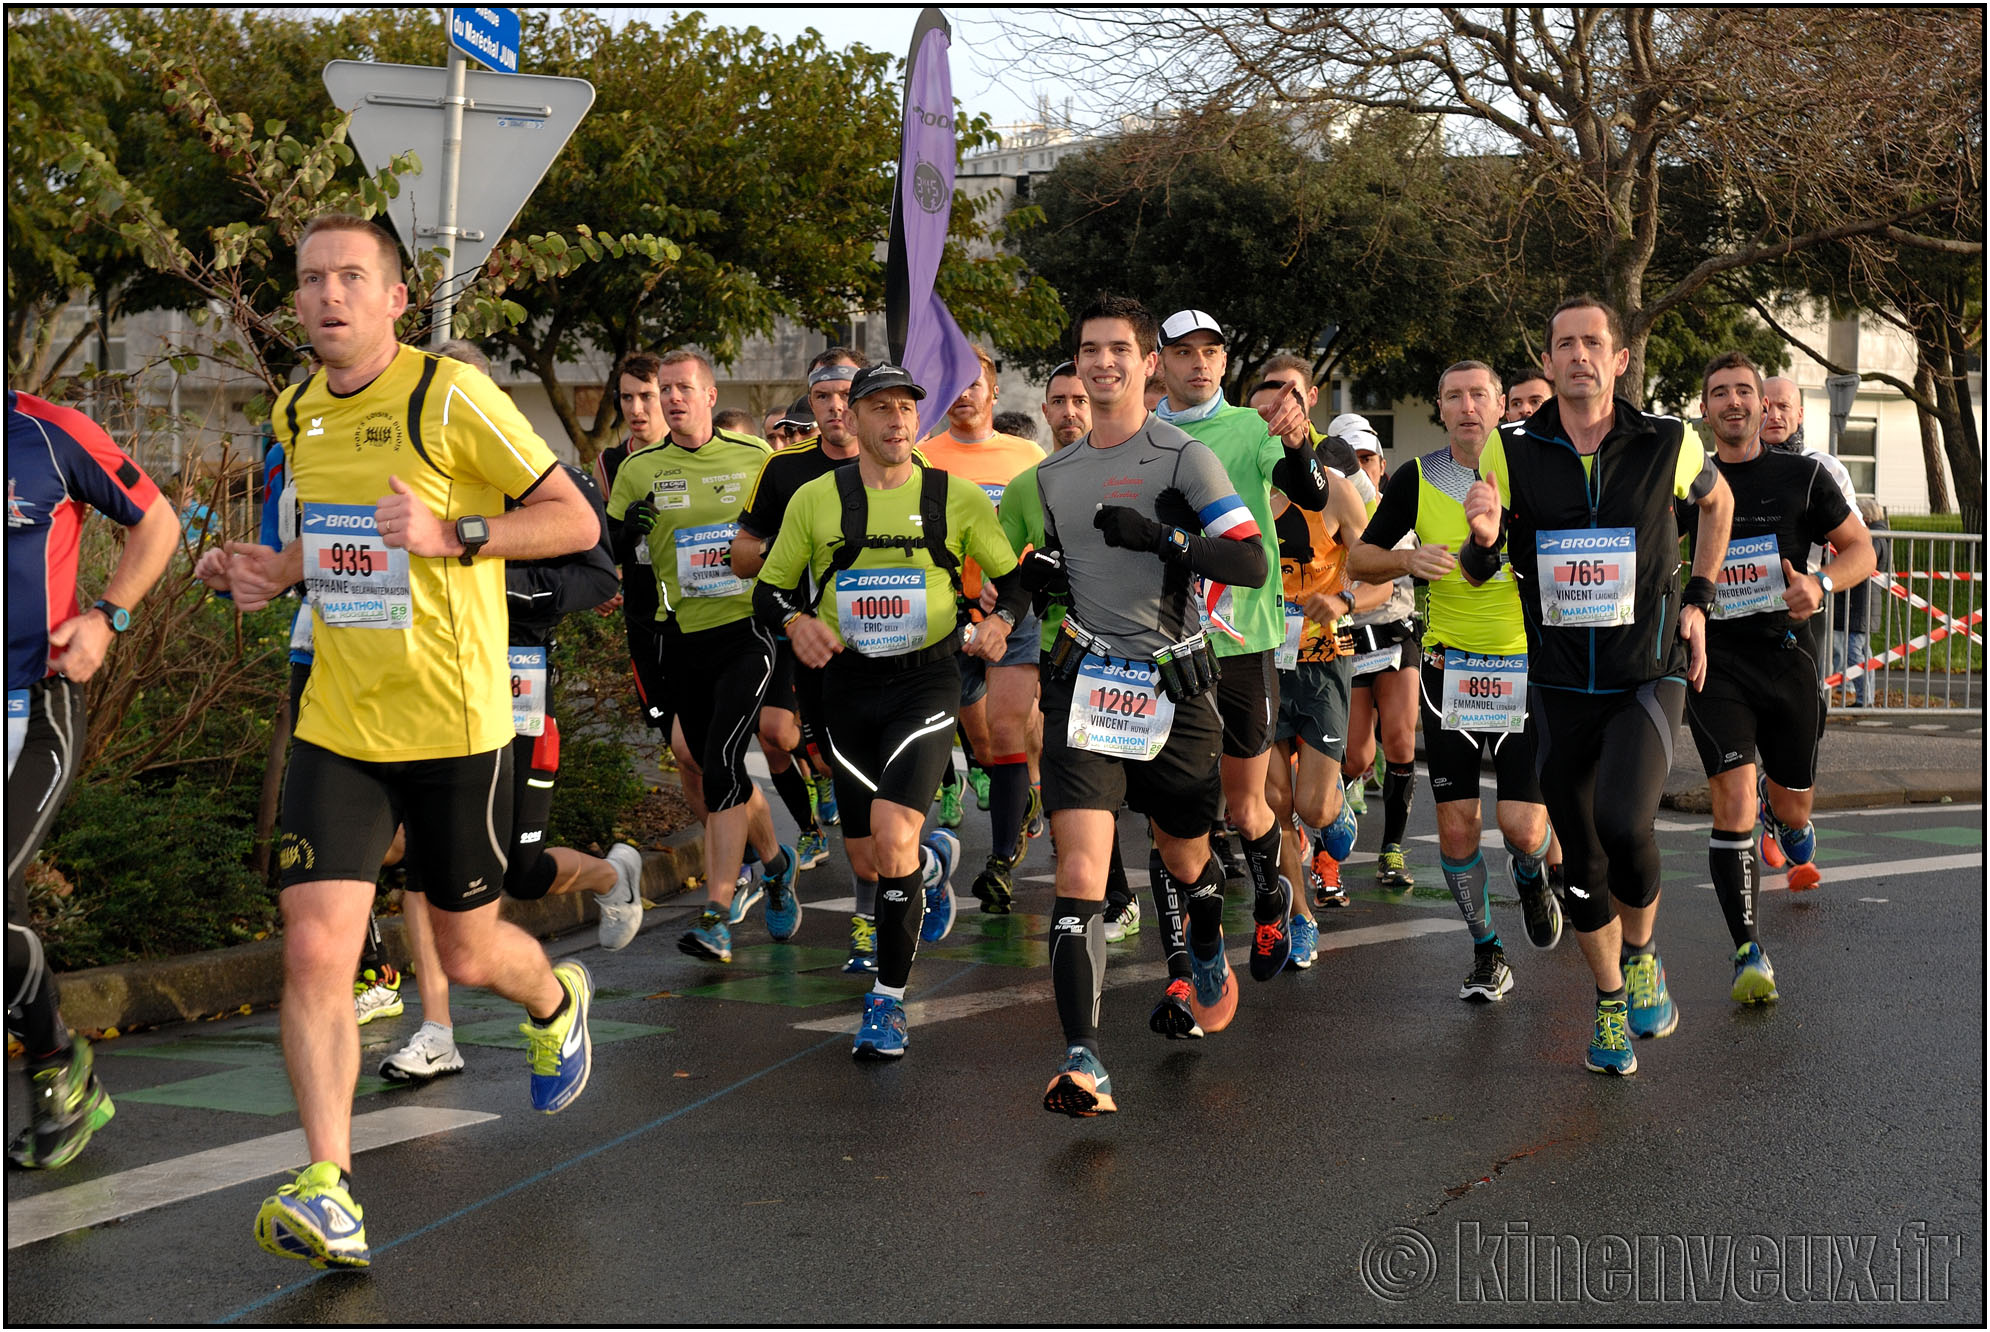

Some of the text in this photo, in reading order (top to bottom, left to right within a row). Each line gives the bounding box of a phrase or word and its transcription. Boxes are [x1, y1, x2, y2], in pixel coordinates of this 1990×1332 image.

[454, 15, 517, 72] du Maréchal JUIN
[325, 513, 378, 529] BROO
[1561, 536, 1631, 550] BROOKS
[1727, 540, 1774, 557] ROOKS
[331, 542, 372, 578] 935
[692, 570, 720, 581] SYLVAIN
[1566, 559, 1606, 587] 765
[1723, 562, 1759, 587] 1173
[696, 579, 737, 592] MARATHON
[857, 574, 921, 587] BROOKS
[1556, 589, 1593, 601] VINCENT
[1718, 585, 1752, 599] FREDERIC
[325, 600, 384, 613] MARATHON
[856, 595, 903, 620] 1000
[1725, 594, 1769, 611] MARATHON
[390, 605, 408, 616] 29
[1562, 603, 1615, 617] MARATHON
[864, 622, 882, 633] ERIC
[858, 633, 907, 647] MARATHON
[1466, 658, 1525, 669] BROOKS
[1469, 676, 1502, 699] 895
[1098, 686, 1149, 719] 1282
[1453, 698, 1495, 711] EMMANUEL
[1090, 714, 1129, 732] VINCENT
[1462, 713, 1507, 722] MARATHON
[1089, 734, 1145, 746] MARATHON
